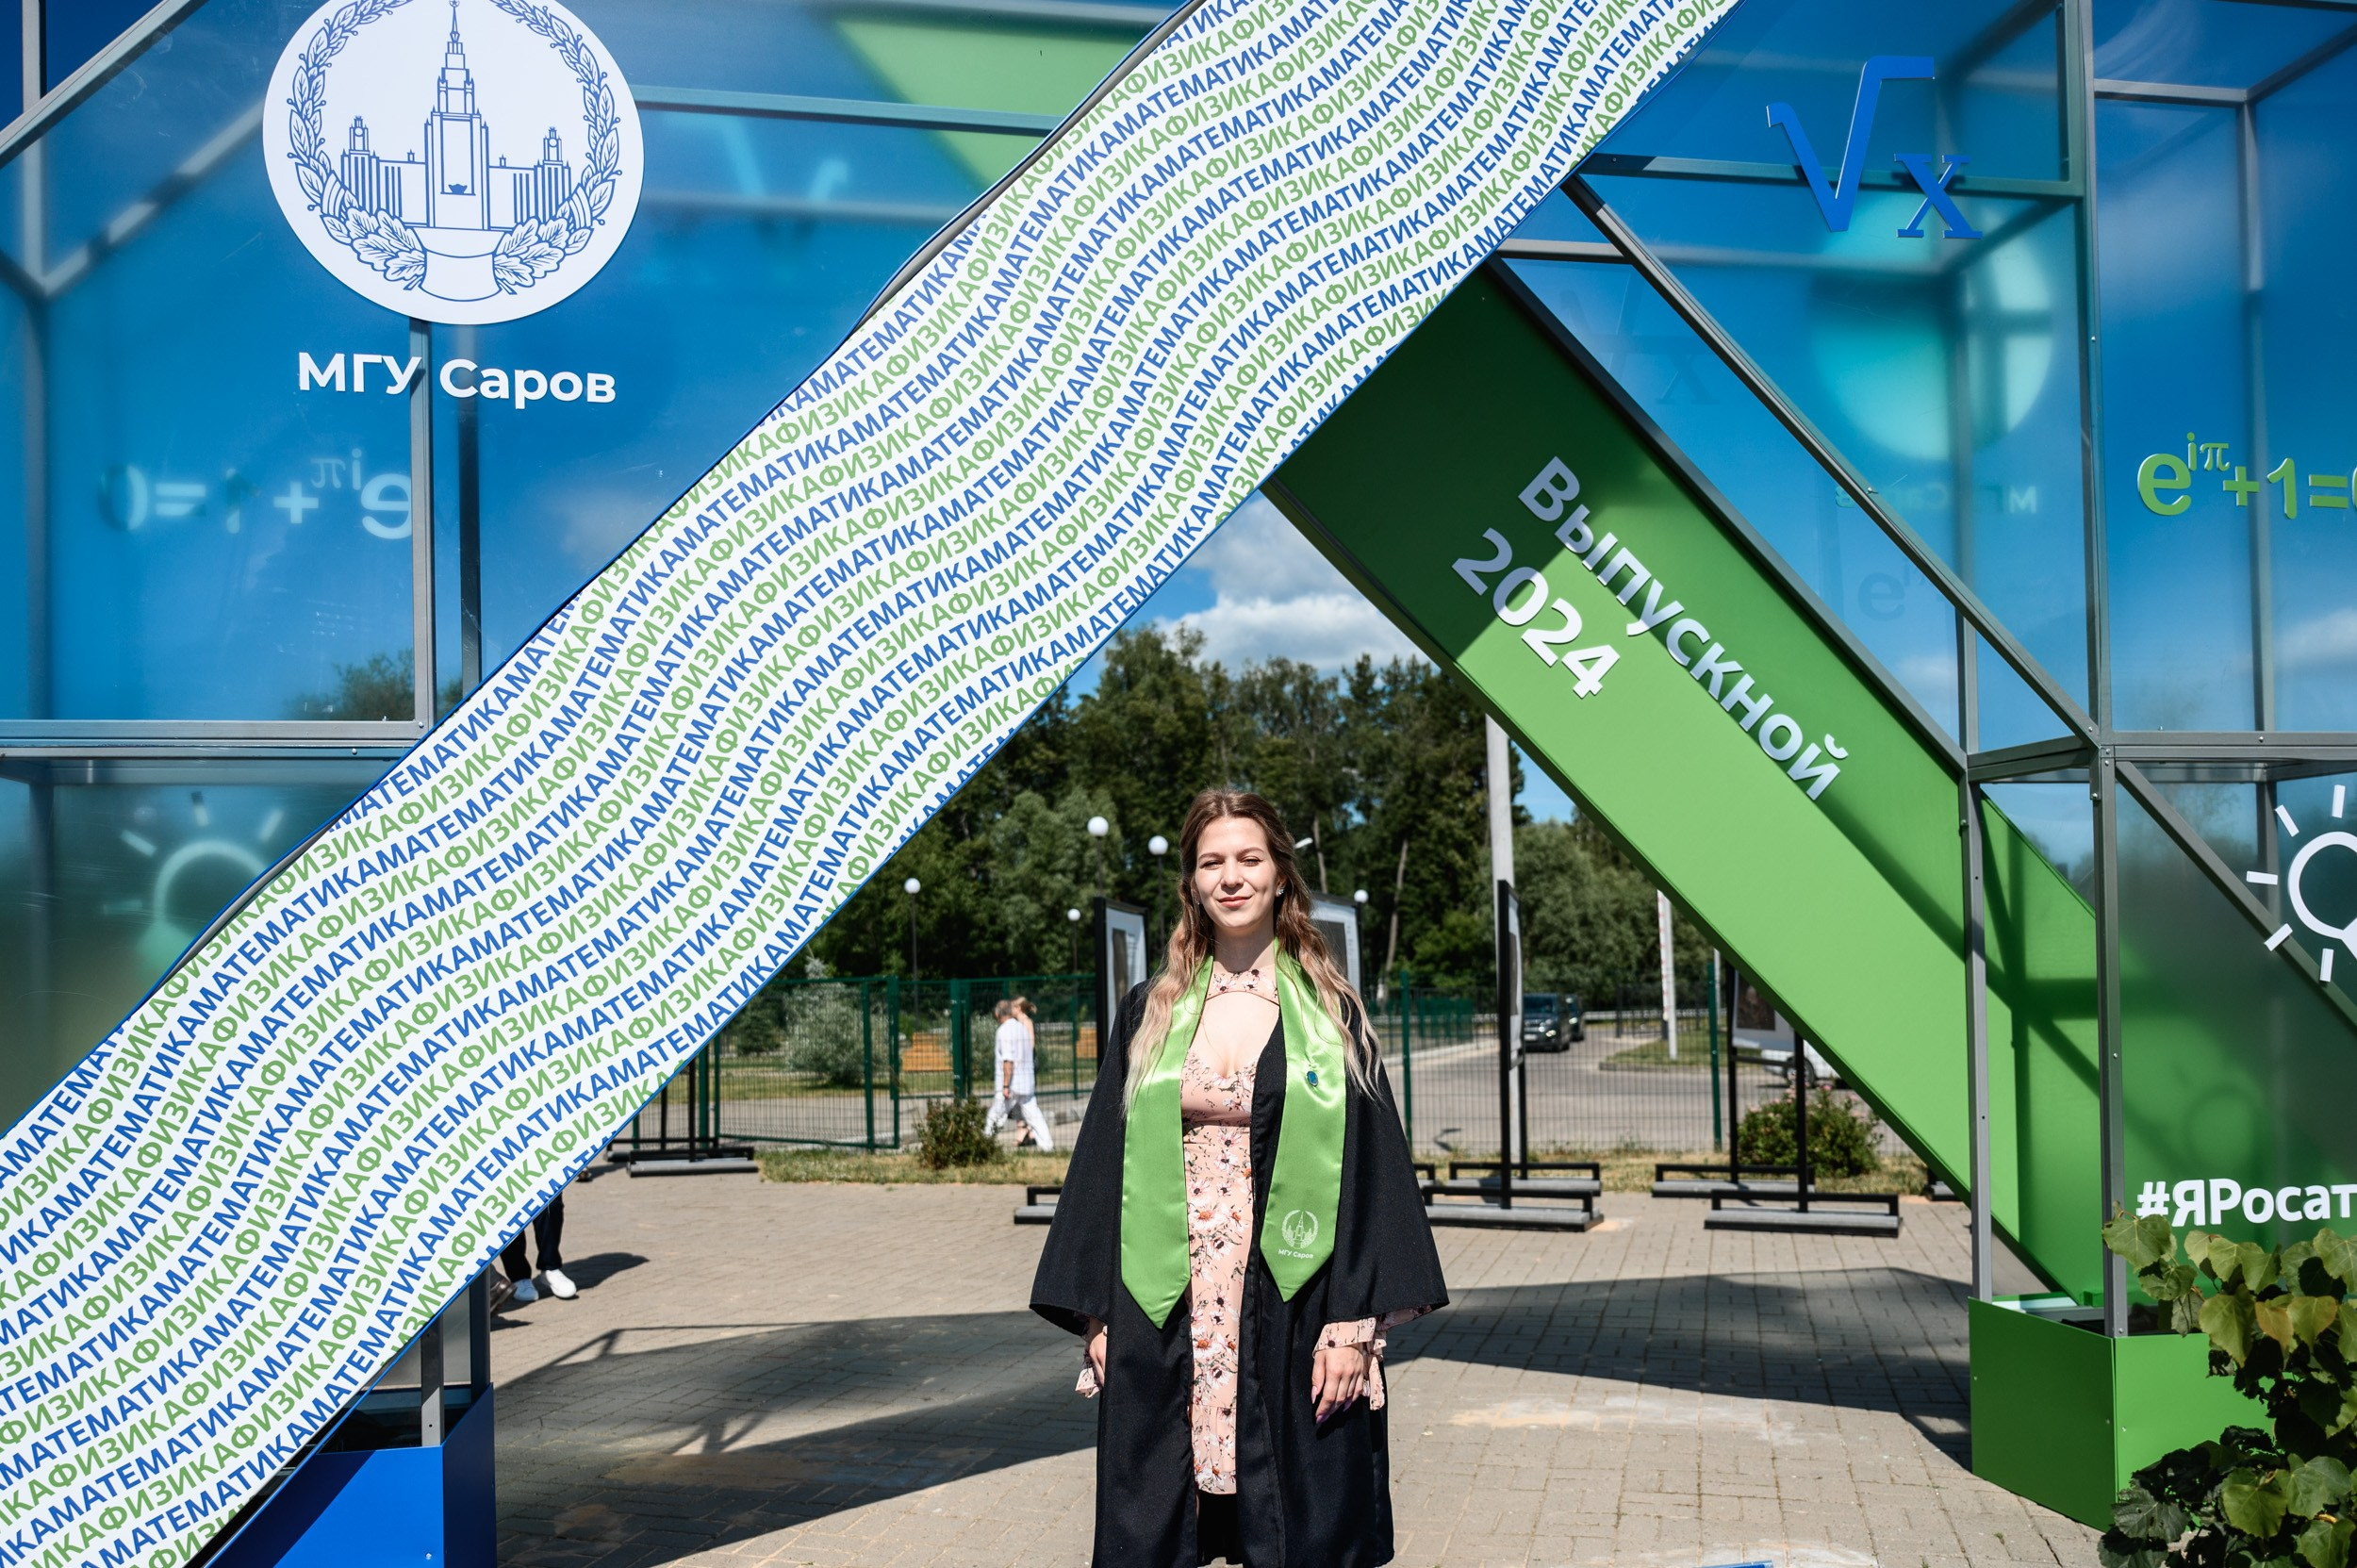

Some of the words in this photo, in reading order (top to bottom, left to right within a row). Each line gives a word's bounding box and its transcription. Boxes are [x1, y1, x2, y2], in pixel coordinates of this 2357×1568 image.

[298, 352, 422, 395] МГУ
[439, 358, 617, 409] Саров
[1452, 527, 1621, 700] 2024
[1518, 456, 1849, 801] Выпускной
[1277, 1248, 1294, 1257] МГУ
[1293, 1251, 1314, 1260] Саров
